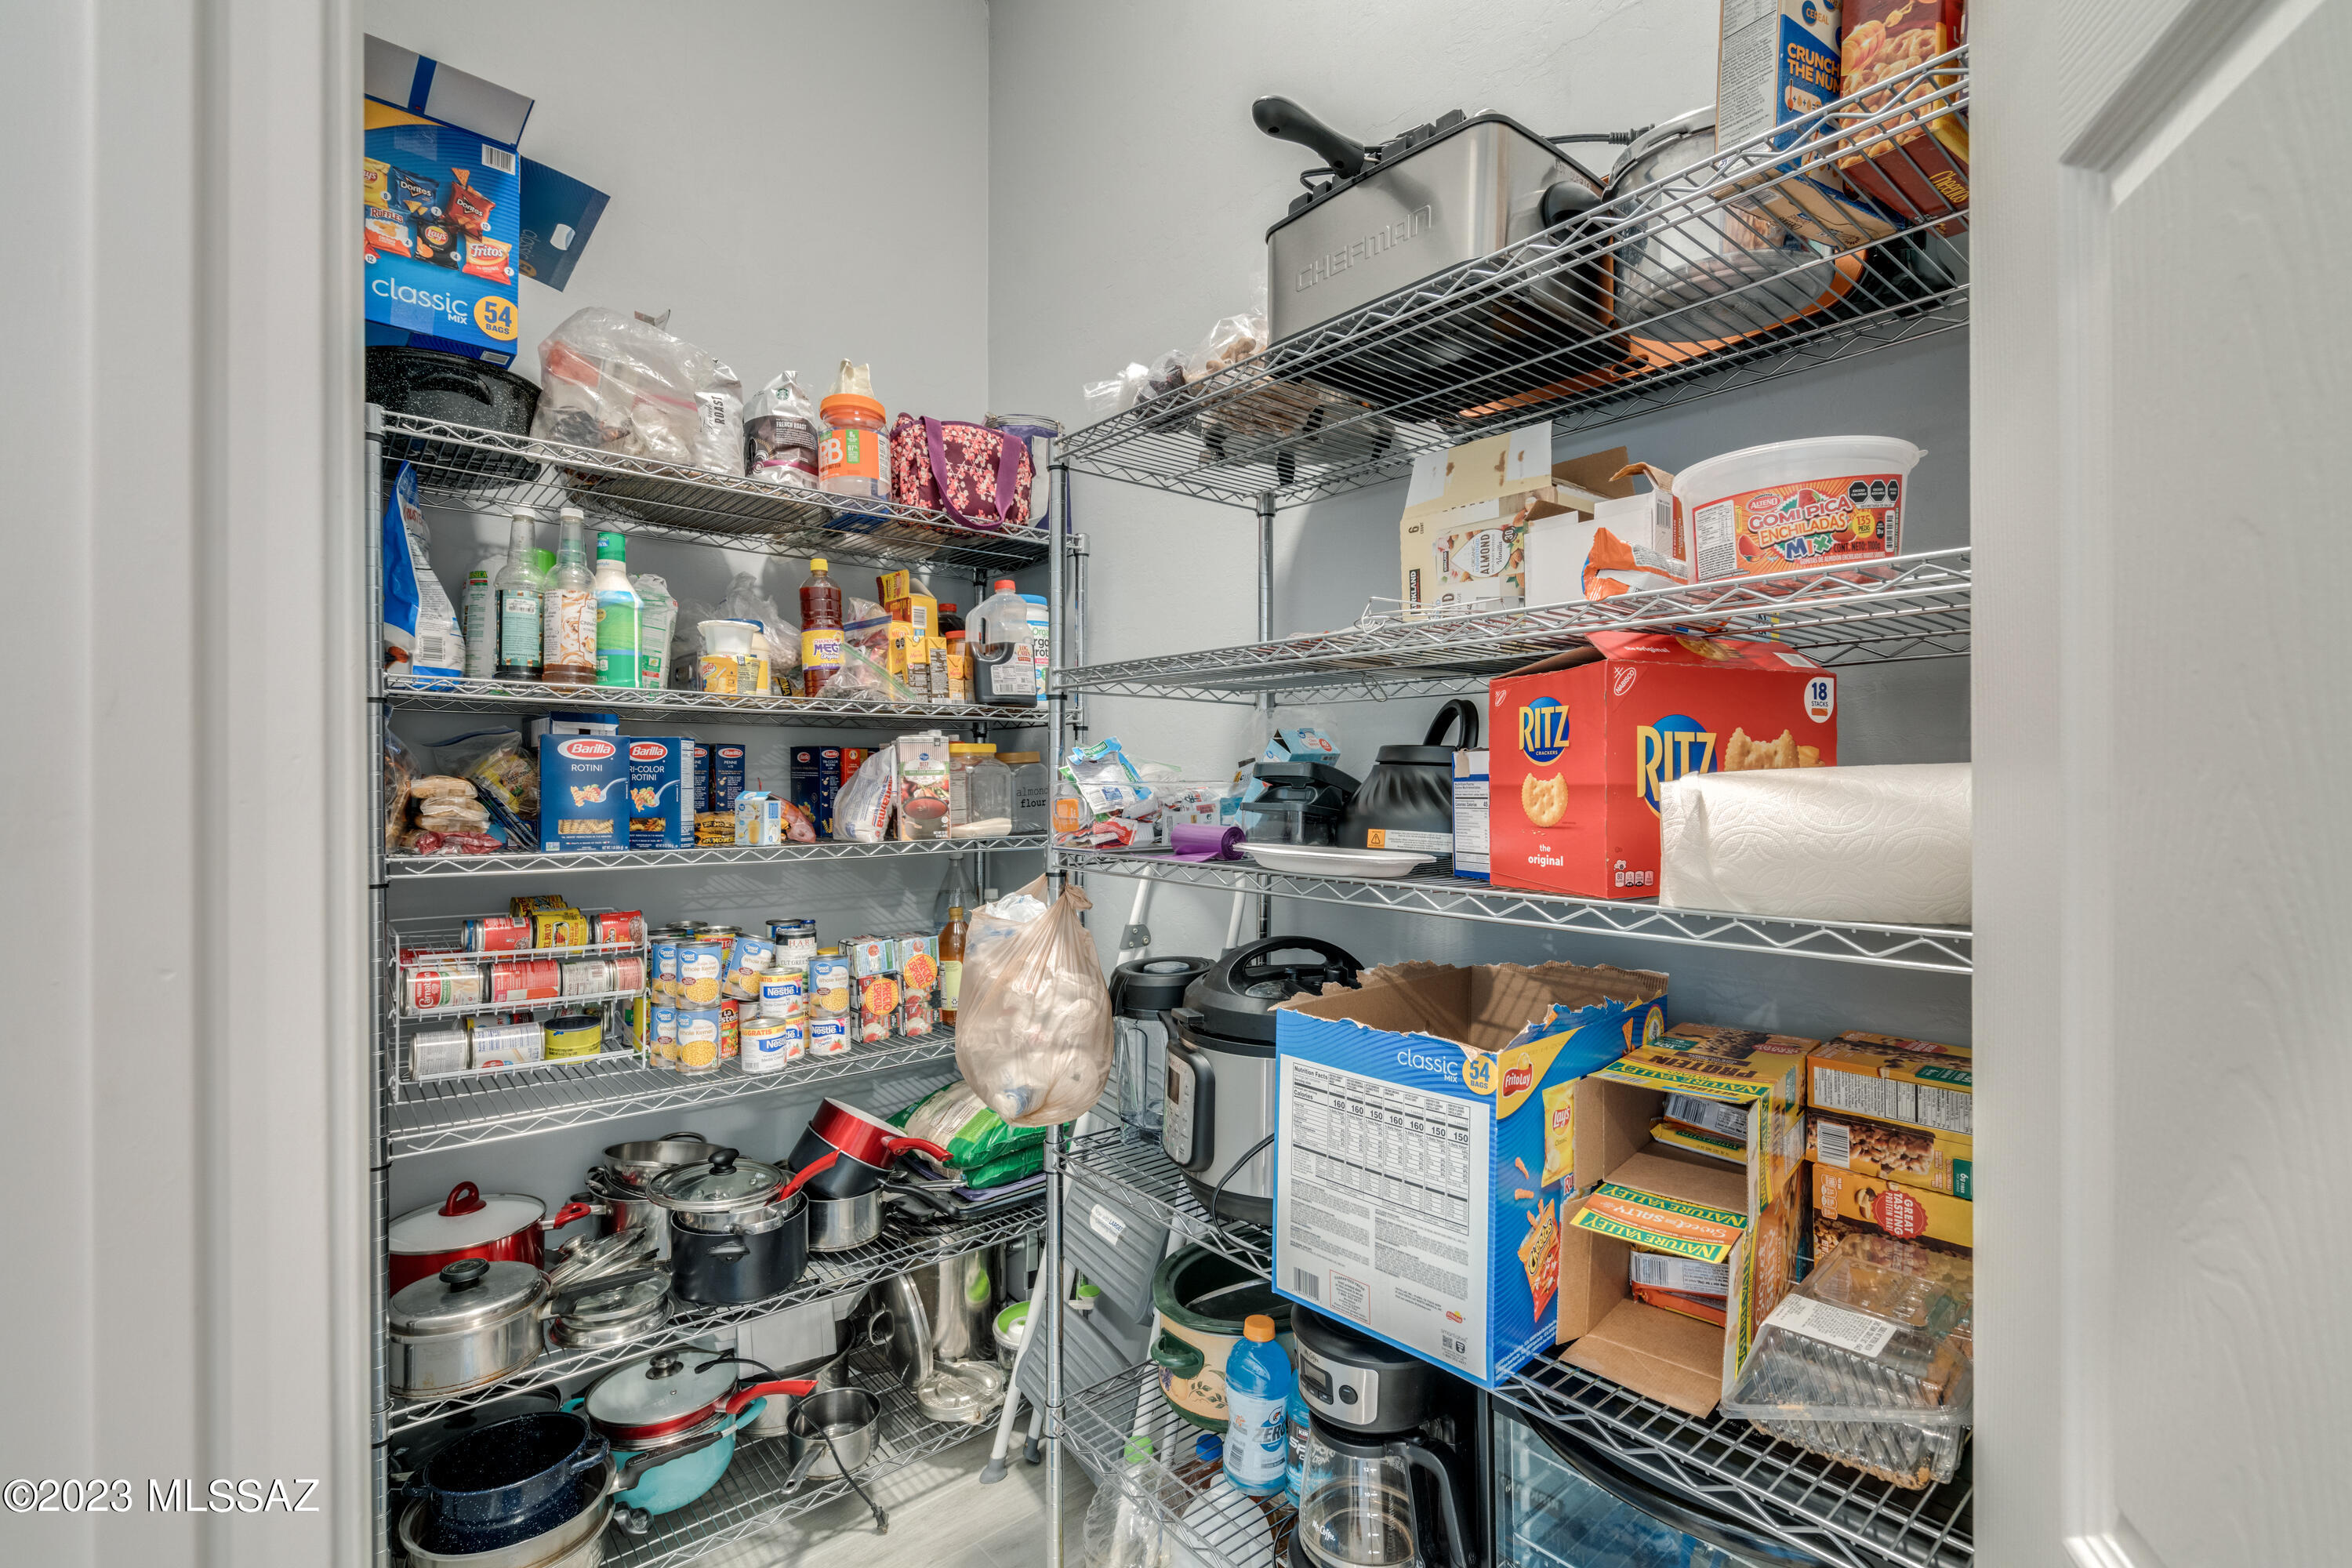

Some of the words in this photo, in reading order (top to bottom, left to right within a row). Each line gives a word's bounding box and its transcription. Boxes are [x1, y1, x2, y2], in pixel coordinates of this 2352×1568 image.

[1806, 8, 1829, 26] CEREAL
[1788, 42, 1841, 76] CRUNCH
[1788, 58, 1813, 82] THE
[401, 181, 432, 197] Doritos
[371, 207, 404, 223] RUFFLES
[456, 198, 484, 217] Doritos
[470, 243, 503, 258] Fritos
[1296, 204, 1432, 292] CHEFMAN
[372, 278, 468, 317] classic
[448, 314, 467, 325] MIX
[484, 301, 512, 328] 54
[485, 323, 510, 335] BAGS
[713, 395, 725, 425] ROAST
[775, 420, 793, 430] FRENCH
[793, 421, 807, 430] ROAST
[1748, 508, 1802, 532] GOMI
[1806, 495, 1853, 517] PICA
[1856, 514, 1871, 526] 135
[1408, 525, 1420, 534] 6
[1504, 529, 1515, 541] 30
[1760, 512, 1848, 547] ENCHILADAS
[1480, 534, 1490, 575] ALMOND
[1785, 535, 1831, 561] MIX
[1833, 543, 1850, 553] CONT.
[1019, 644, 1029, 652] LOG
[1615, 668, 1636, 695] NABISCO
[1811, 682, 1828, 701] 18
[1519, 705, 1570, 753] RITZ
[572, 743, 612, 754] Barilla
[632, 746, 663, 757] Barilla
[571, 764, 603, 772] ROTINI
[1636, 724, 1718, 799] RITZ
[1020, 798, 1047, 809] flour
[1539, 844, 1552, 853] the
[1528, 854, 1564, 867] original
[543, 924, 552, 940] PATO
[908, 960, 926, 987] ESPECIAL
[915, 954, 935, 983] PRECIO
[768, 985, 795, 997] Nestlé
[873, 982, 882, 1012] ESPECIAL
[882, 981, 893, 1012] PRECIO
[812, 1024, 836, 1035] Nestlé
[1397, 1049, 1459, 1076] classic
[1468, 1060, 1490, 1082] 54
[1648, 1054, 1758, 1078] PROTEIN
[1294, 1065, 1315, 1076] Nutrition
[1315, 1071, 1328, 1080] Facts
[1443, 1075, 1458, 1083] MIX
[1613, 1062, 1681, 1083] VALLEY
[1470, 1080, 1489, 1090] BAGS
[1677, 1074, 1762, 1094] NATURE
[1294, 1090, 1314, 1100] Calories
[1334, 1099, 1345, 1109] 160
[1351, 1105, 1364, 1115] 160
[1370, 1110, 1383, 1120] 150
[1552, 1106, 1571, 1129] Lay's
[1390, 1115, 1403, 1126] 160
[1410, 1121, 1425, 1131] 160
[1432, 1127, 1446, 1138] 150
[1454, 1132, 1468, 1143] 150
[1959, 1172, 1969, 1184] 6g
[1602, 1185, 1667, 1209] VALLEY
[1885, 1192, 1893, 1218] PROTEIN
[1613, 1205, 1665, 1223] SALTY
[1668, 1203, 1747, 1228] NATURE
[1893, 1192, 1904, 1236] TASTING
[1904, 1198, 1915, 1234] GREAT
[1584, 1214, 1646, 1242] VALLEY
[1675, 1220, 1727, 1239] Sweet
[1885, 1218, 1893, 1232] BAR!
[1528, 1219, 1554, 1276] Cheetos
[1646, 1233, 1716, 1259] NATURE
[1252, 1426, 1287, 1445] ZERO
[1312, 1519, 1320, 1531] Mr.
[1319, 1525, 1336, 1541] Coffee
